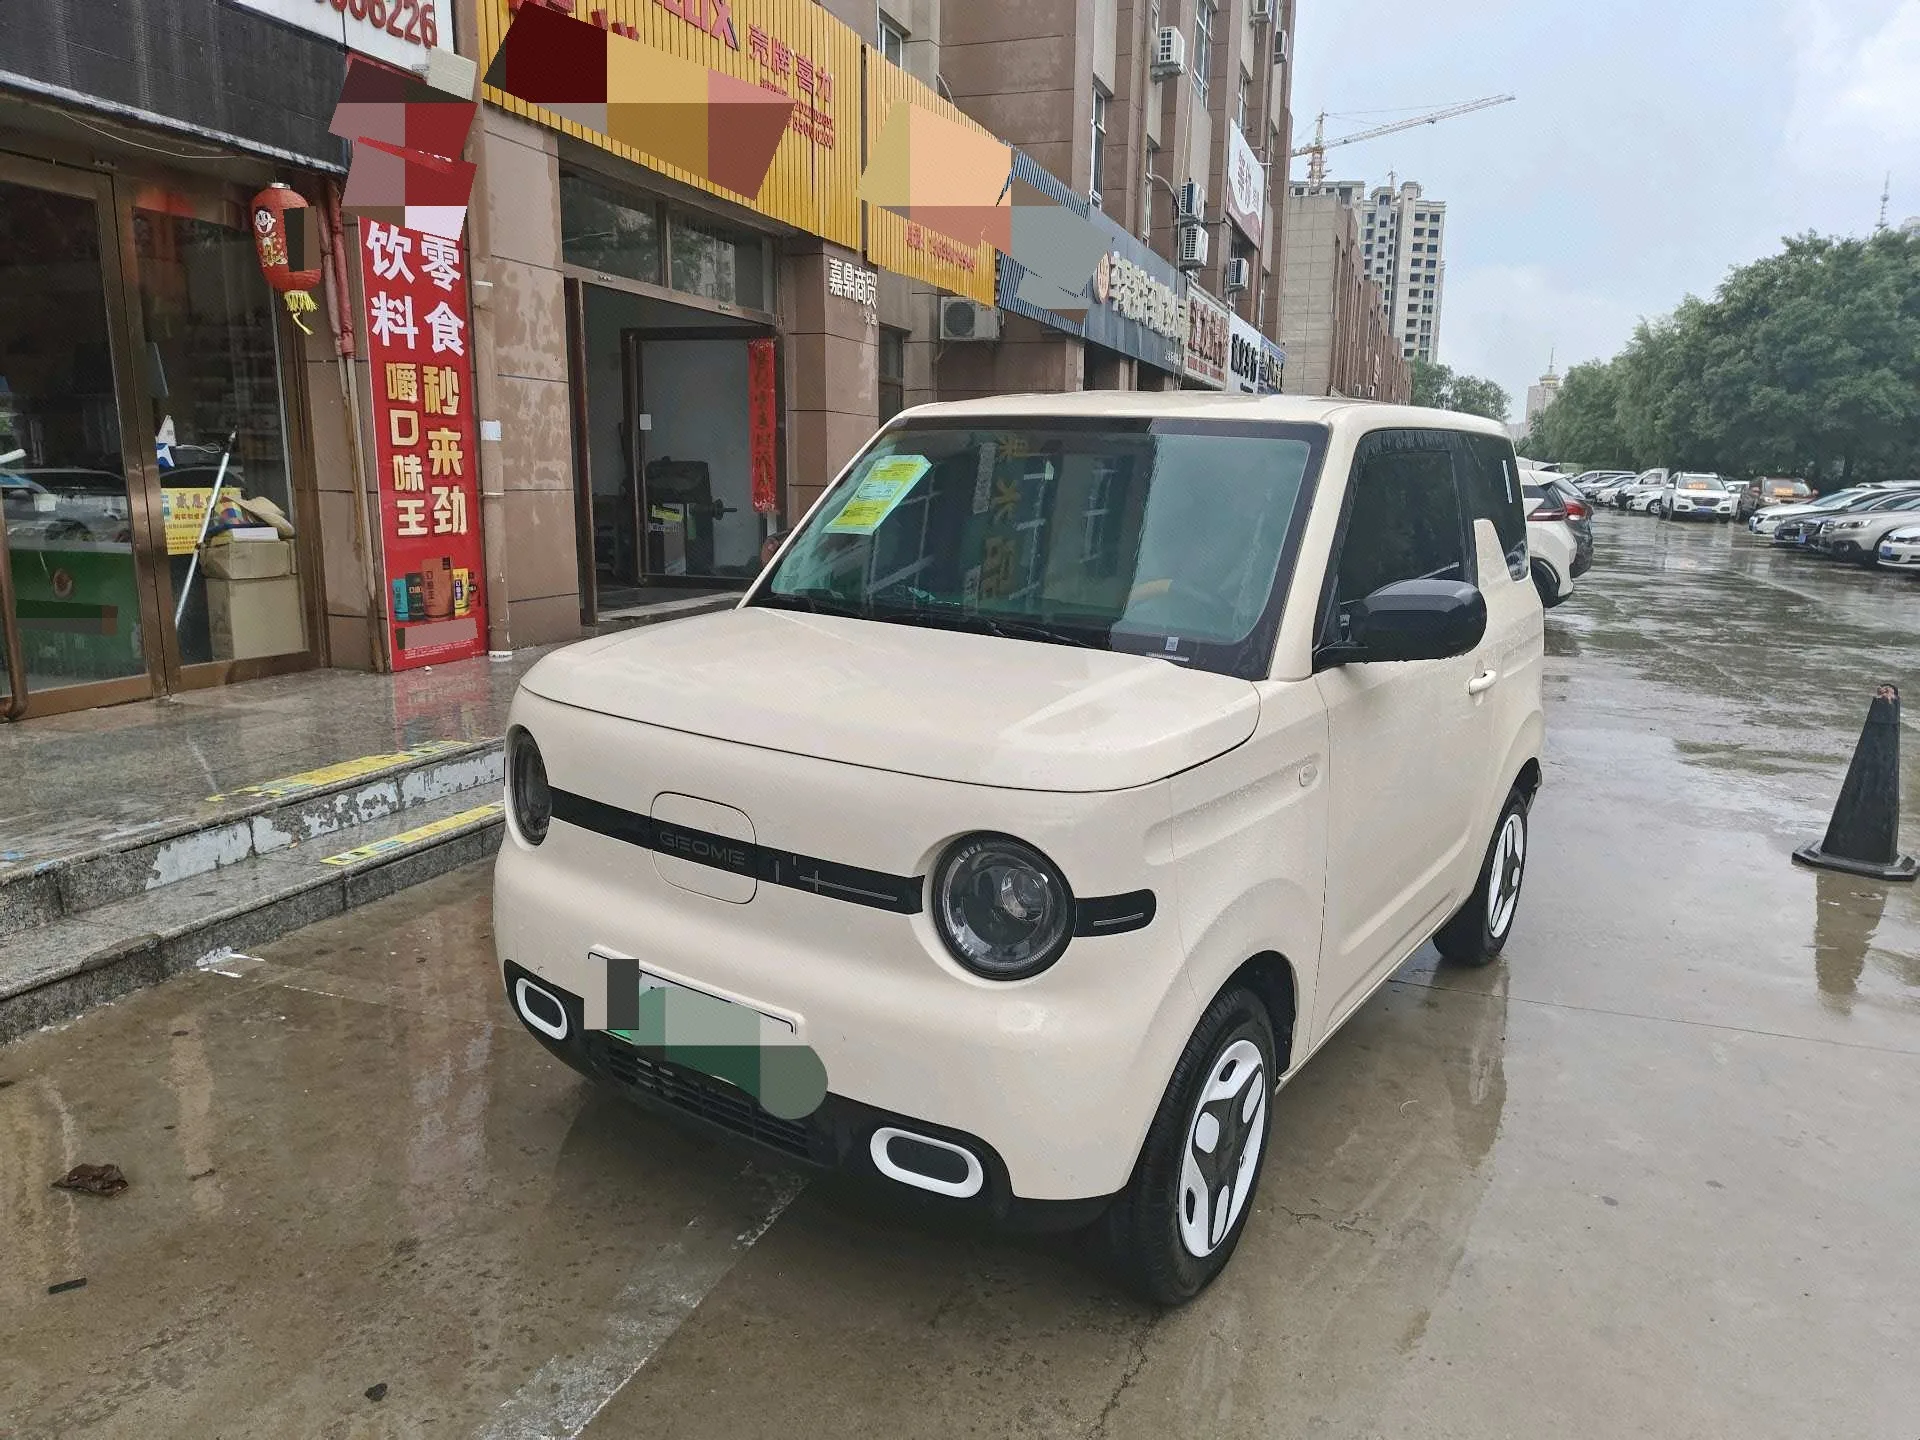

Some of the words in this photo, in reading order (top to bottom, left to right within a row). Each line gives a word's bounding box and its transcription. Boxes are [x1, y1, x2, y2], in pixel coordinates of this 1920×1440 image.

[748, 23, 833, 103] 壳牌喜力
[366, 220, 419, 350] 饮料
[420, 233, 465, 357] 零食
[829, 258, 878, 309] 嘉鼎商贸
[385, 362, 429, 537] 嚼口味王
[422, 364, 469, 536] 秒来劲
[659, 830, 746, 867] GEOME
